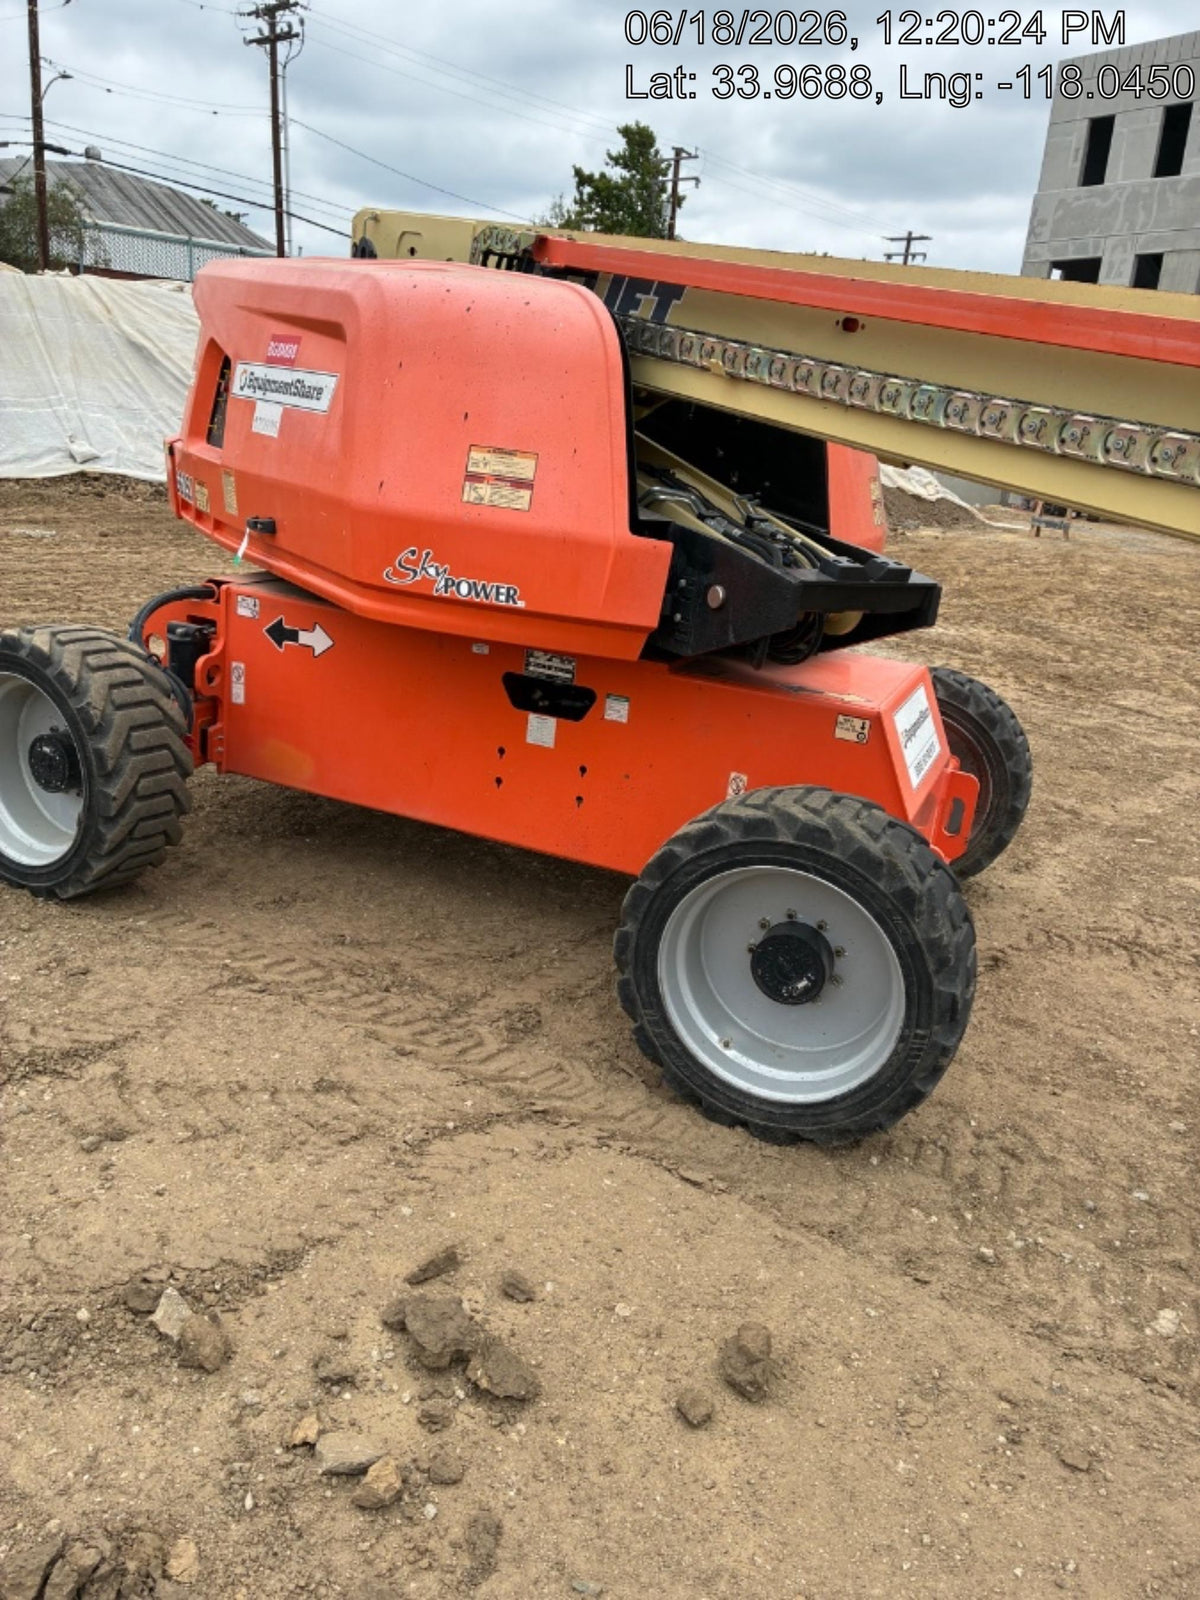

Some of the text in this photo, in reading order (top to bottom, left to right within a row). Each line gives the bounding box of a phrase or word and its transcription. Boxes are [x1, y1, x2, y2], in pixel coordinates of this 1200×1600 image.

[246, 371, 324, 401] EquipmentShare
[384, 547, 520, 606] Sky POWER
